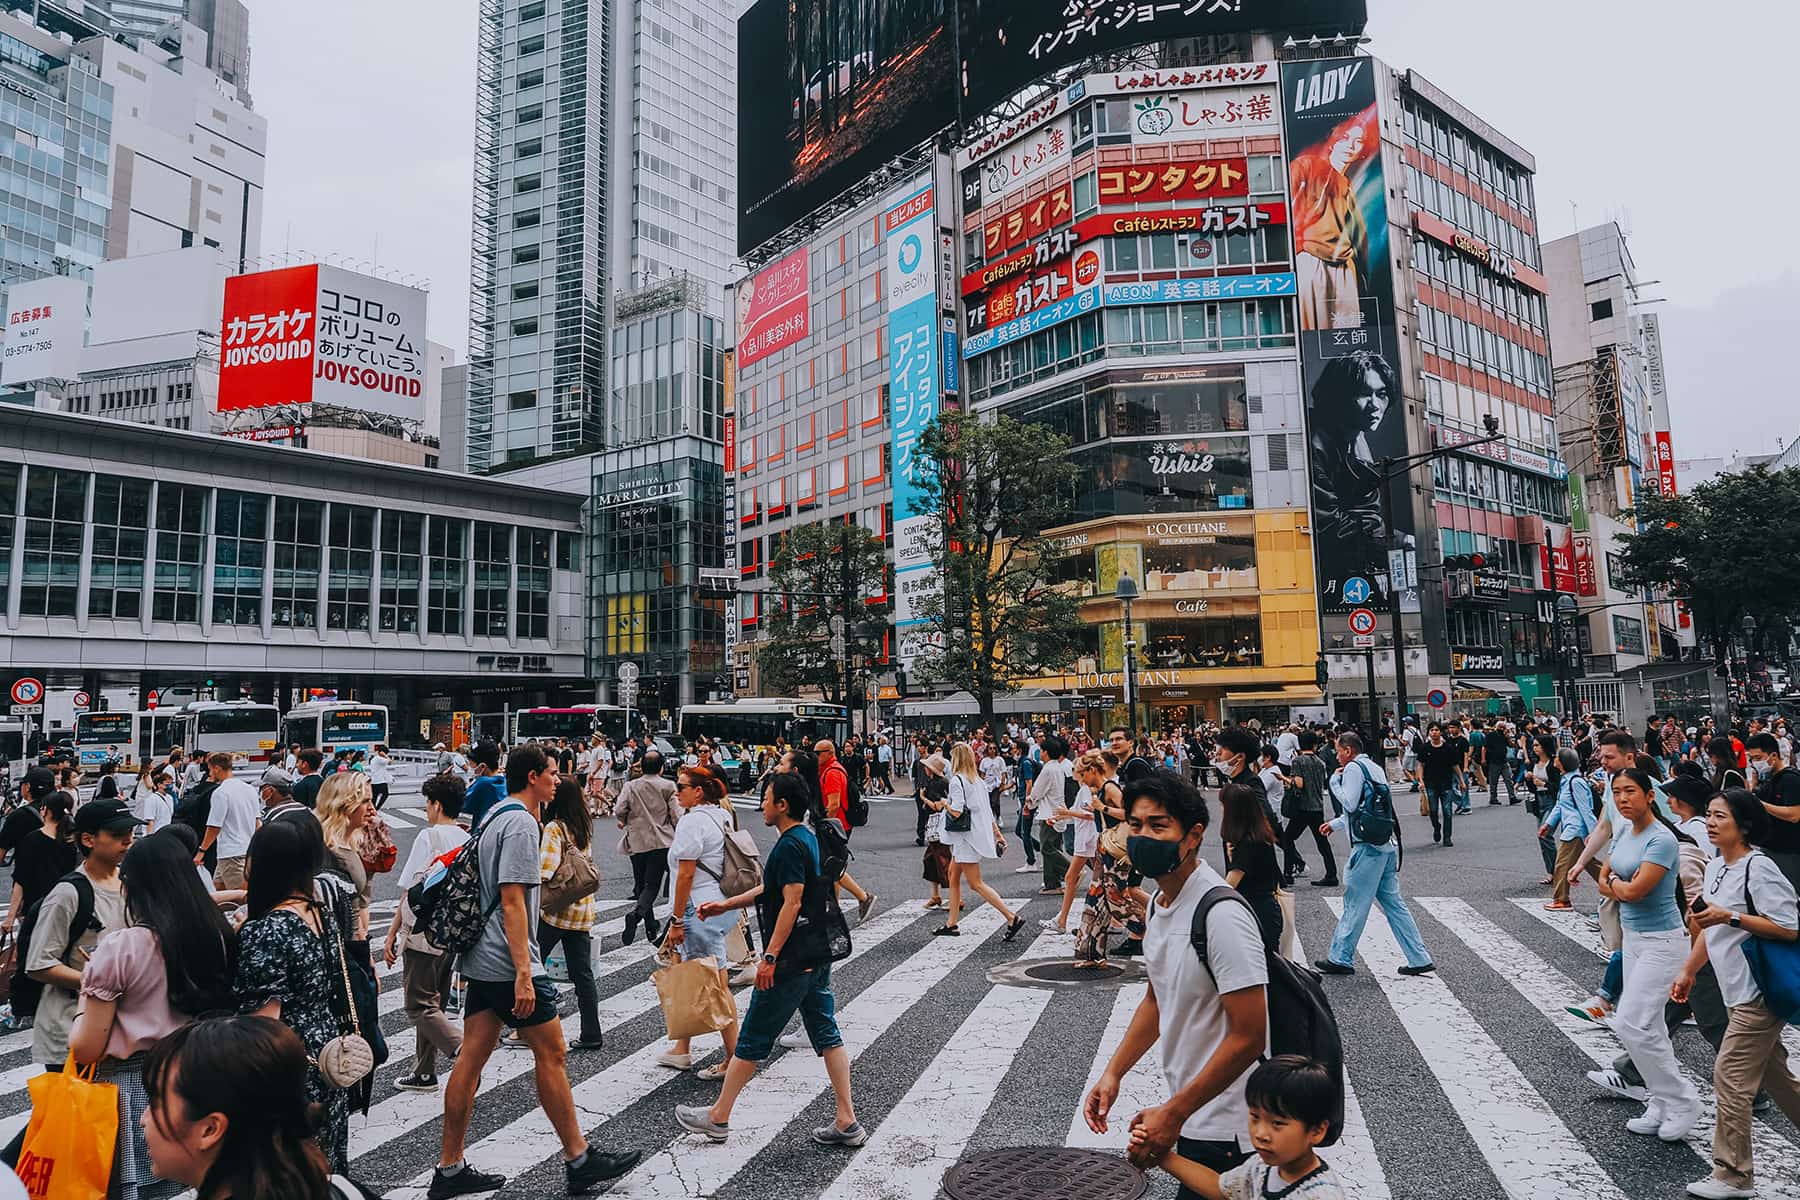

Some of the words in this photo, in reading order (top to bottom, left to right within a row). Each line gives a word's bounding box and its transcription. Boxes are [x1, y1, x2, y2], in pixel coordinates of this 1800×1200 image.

[1115, 64, 1268, 90] しゃぶしゃぶバイキング
[1182, 94, 1273, 126] しゃぶ葉
[1011, 129, 1064, 176] しゃぶ葉
[965, 180, 980, 200] 9F
[1100, 161, 1244, 197] コンタクト
[985, 192, 1072, 251] プライス
[1202, 206, 1270, 234] ガスト
[1036, 229, 1078, 268] ガスト
[1015, 272, 1068, 317] ガスト
[1110, 286, 1153, 300] AEON
[321, 288, 401, 327] ココロの
[968, 304, 986, 328] 7F
[225, 308, 312, 346] カラオケ
[1331, 328, 1368, 345] 玄師
[223, 339, 312, 368] JOYSOUND
[315, 359, 422, 399] JOYSOUND
[894, 331, 916, 482] アイシティ
[254, 427, 290, 440] JOYSOUND
[1148, 454, 1215, 474] Ushi8
[1553, 461, 1566, 478] 4F
[599, 489, 641, 507] MARK
[647, 482, 682, 497] CITY
[619, 477, 659, 490] SHIBUYA
[1147, 522, 1229, 537] L'OCCITANE
[1175, 600, 1208, 614] Café
[1537, 599, 1555, 624] LU
[1078, 670, 1182, 689] L'OCCTANE
